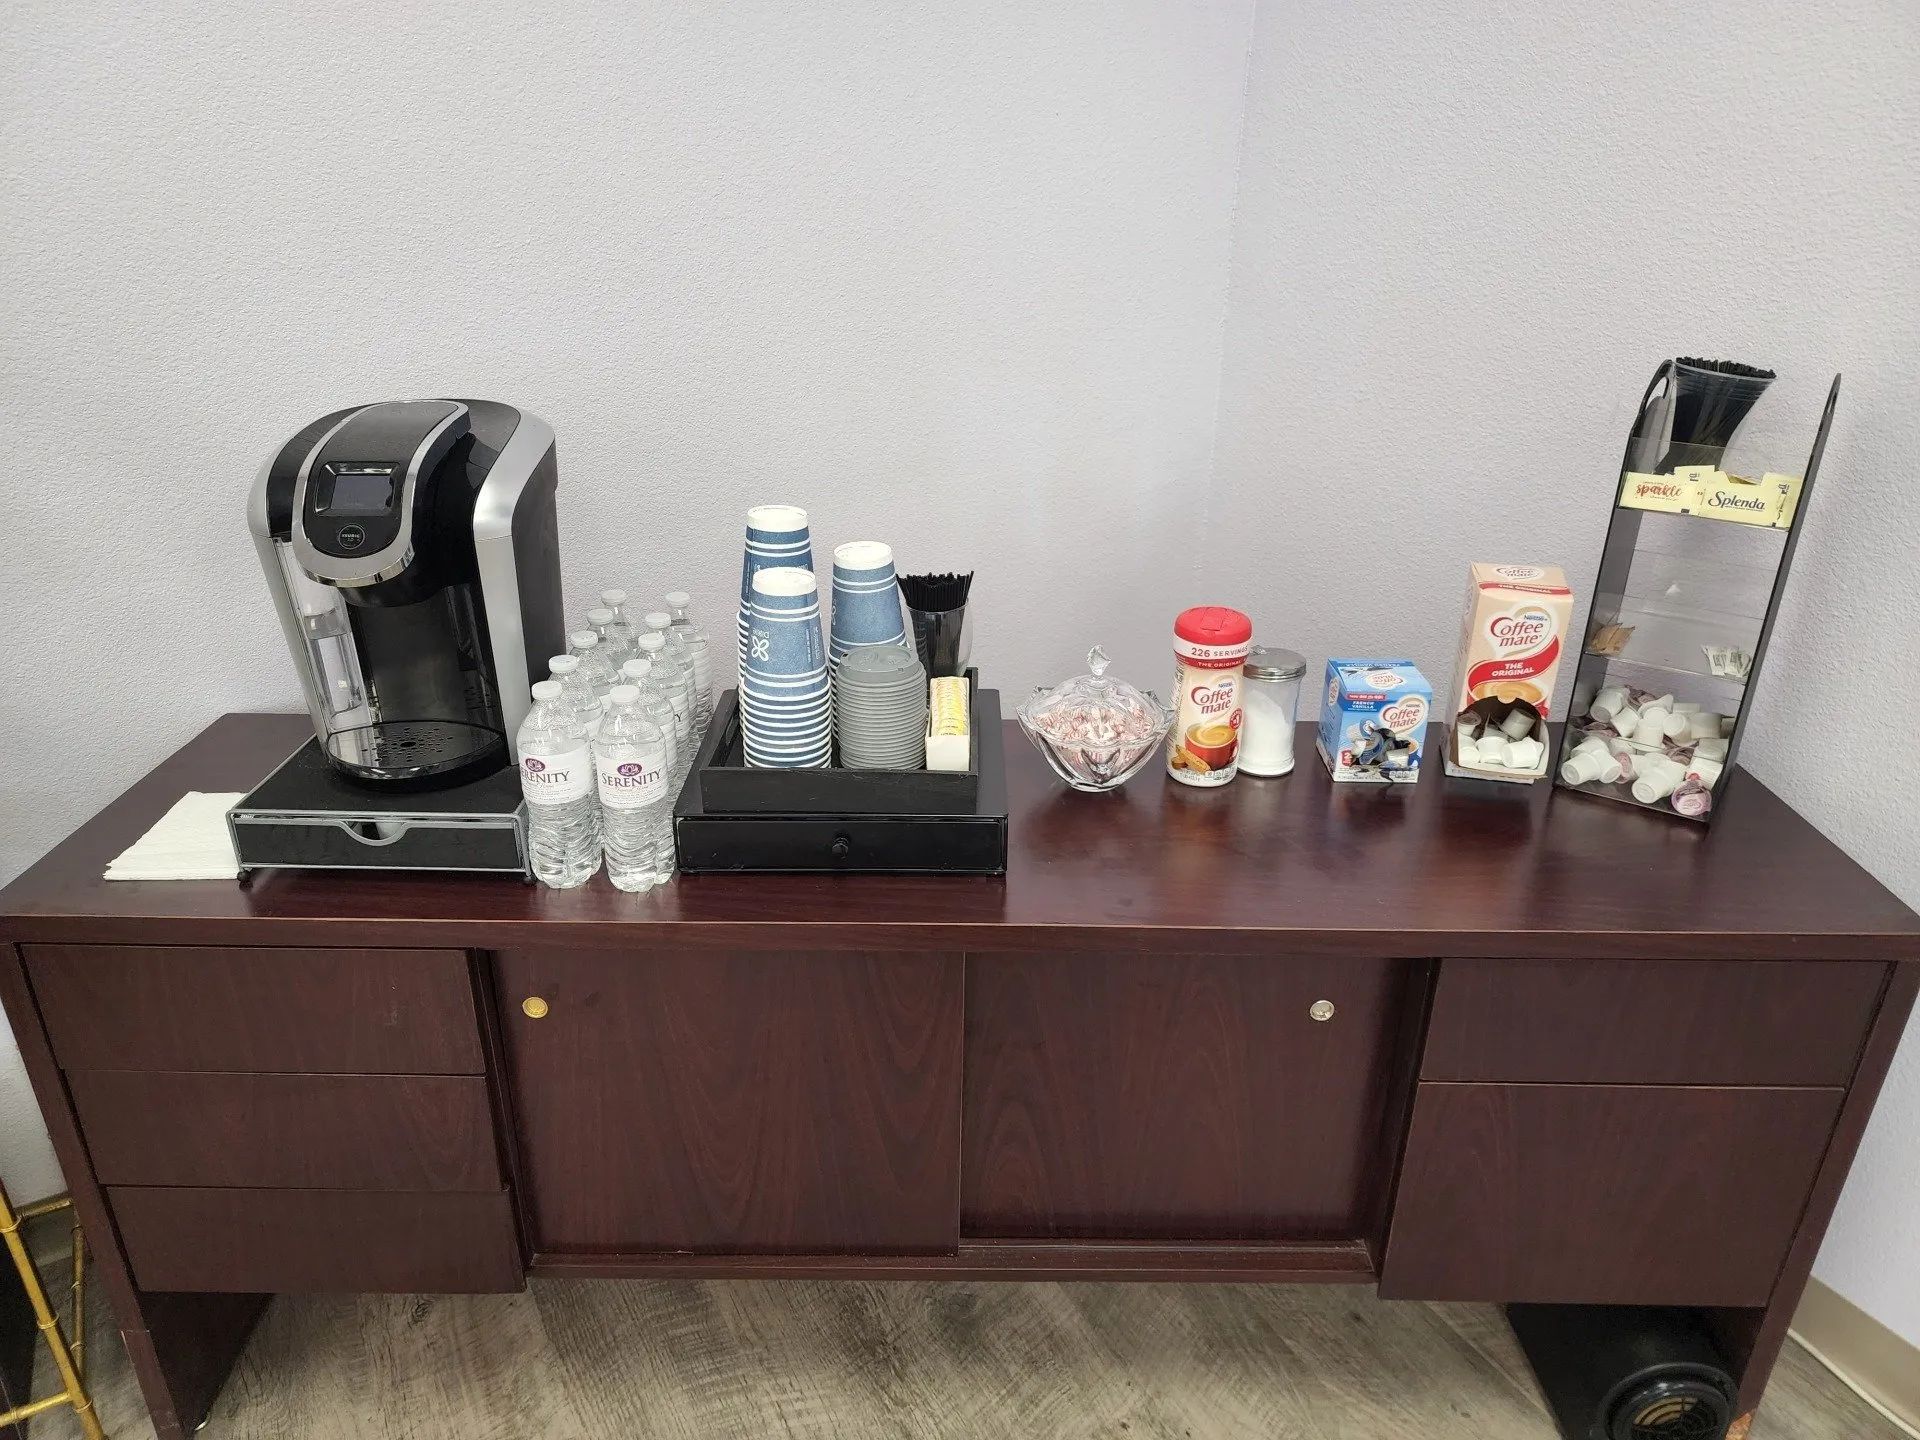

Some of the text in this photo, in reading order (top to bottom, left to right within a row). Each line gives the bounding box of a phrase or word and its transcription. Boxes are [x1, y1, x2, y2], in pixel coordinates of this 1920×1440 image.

[1708, 491, 1765, 509] Splenda
[1490, 616, 1544, 638] Coffee
[1499, 634, 1539, 647] mate
[1191, 644, 1248, 657] 226 SERVINGS
[1213, 660, 1241, 668] ORIGINAL
[1504, 662, 1524, 670] THE
[1491, 667, 1535, 677] ORIGINAL
[1191, 686, 1234, 706] Coffee
[1201, 699, 1231, 715] mate
[1382, 706, 1420, 722] Coffee
[1389, 717, 1417, 728] mate
[601, 768, 661, 788] SERENITY
